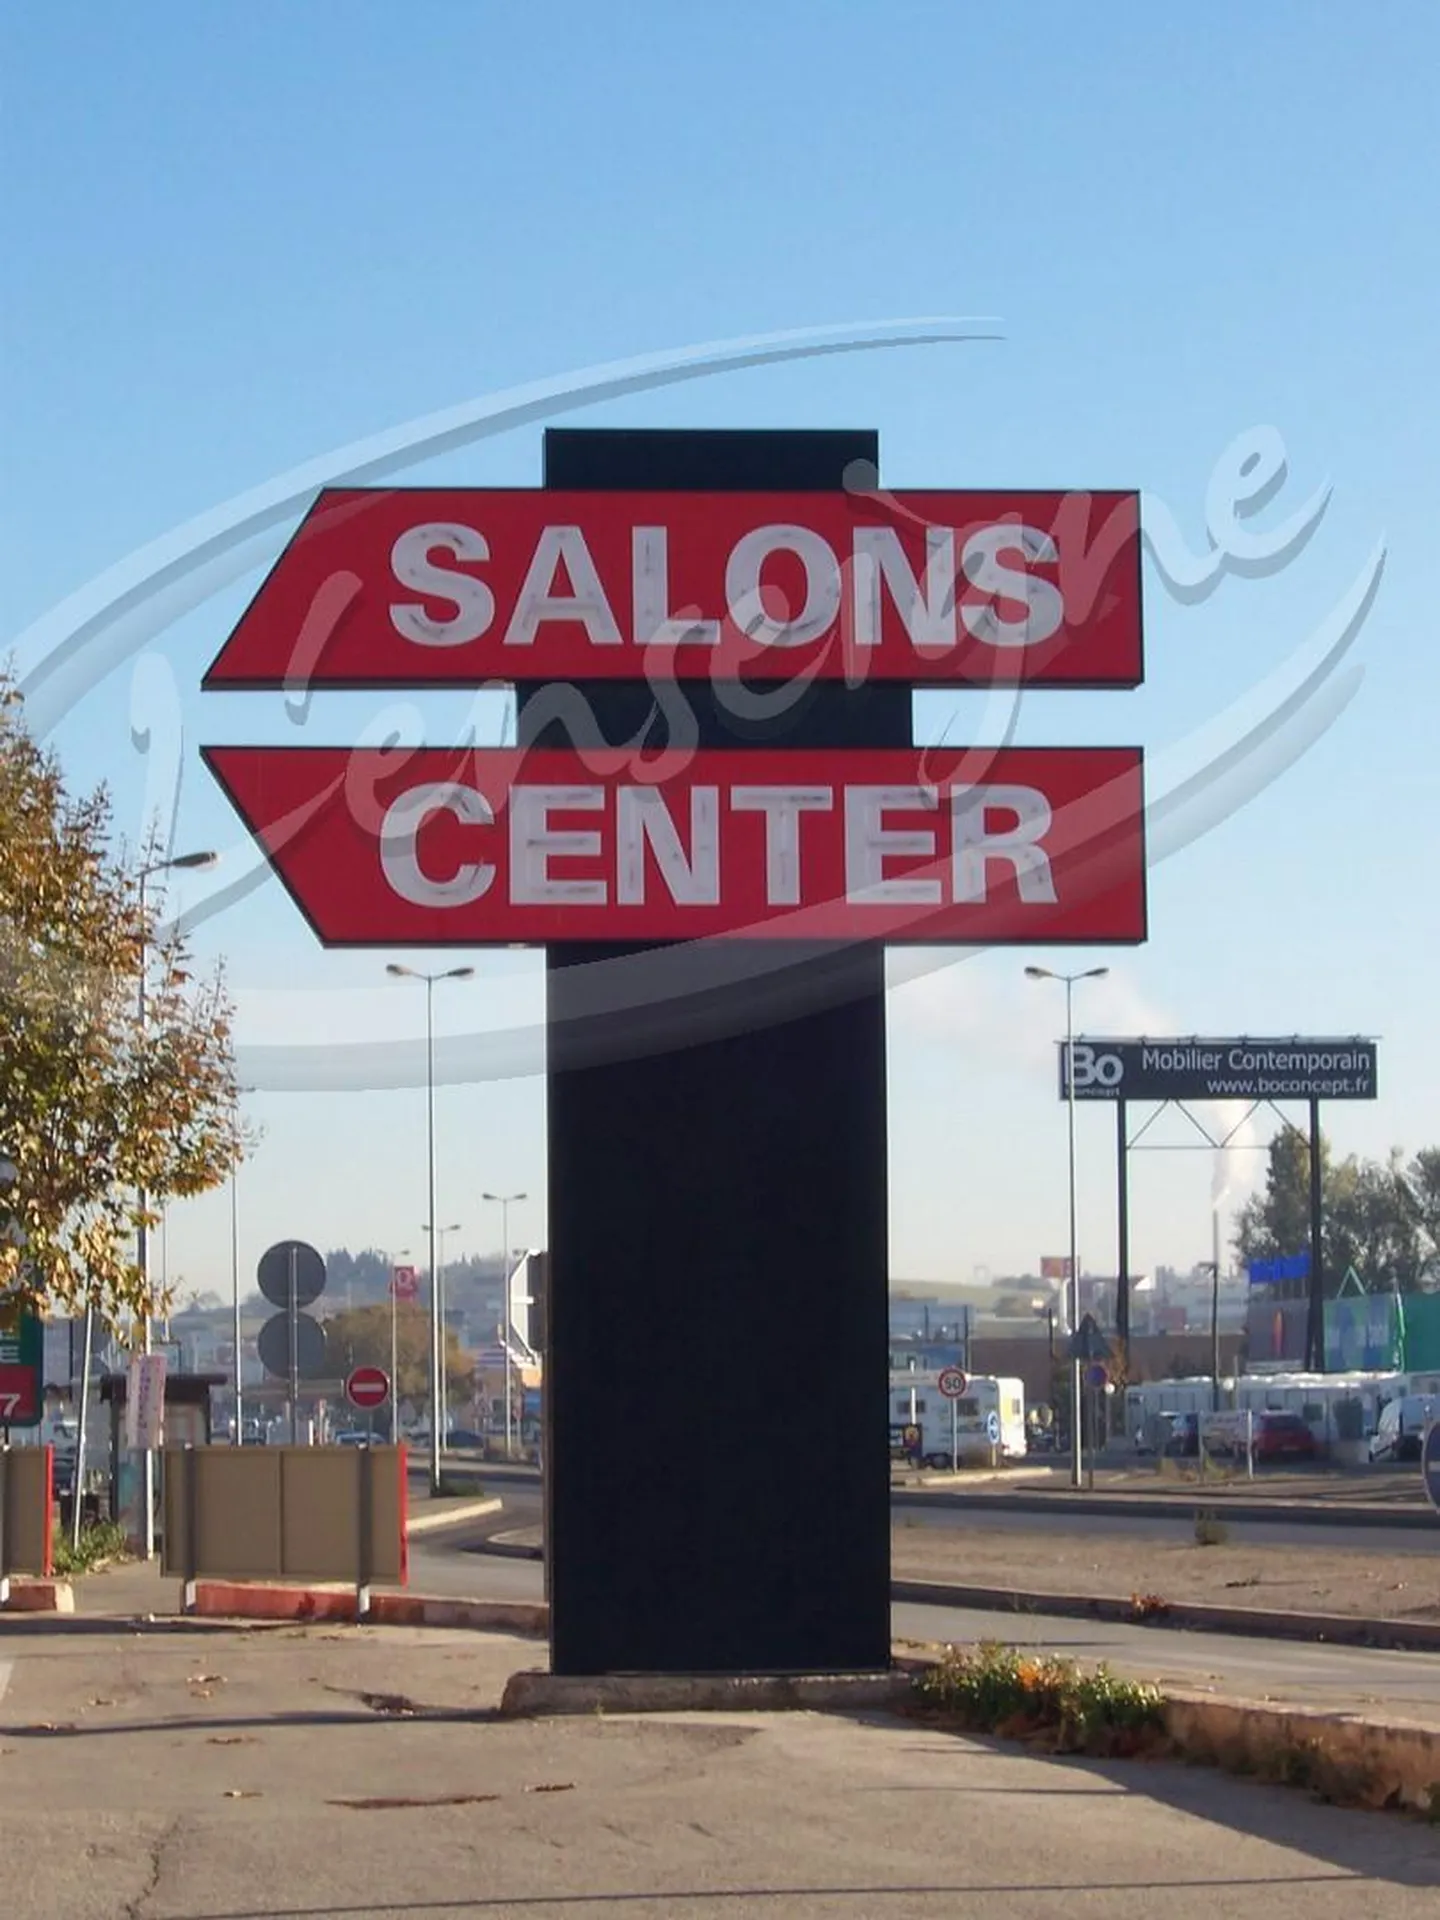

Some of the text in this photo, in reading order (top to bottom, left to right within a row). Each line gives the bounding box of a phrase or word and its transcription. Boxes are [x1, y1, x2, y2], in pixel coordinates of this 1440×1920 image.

[388, 522, 1064, 648] SALONS
[380, 782, 1059, 908] CENTER
[1064, 1045, 1124, 1087] Bo
[1142, 1048, 1371, 1075] Mobilier Contemporain
[1206, 1075, 1369, 1096] www.boconcept.fr
